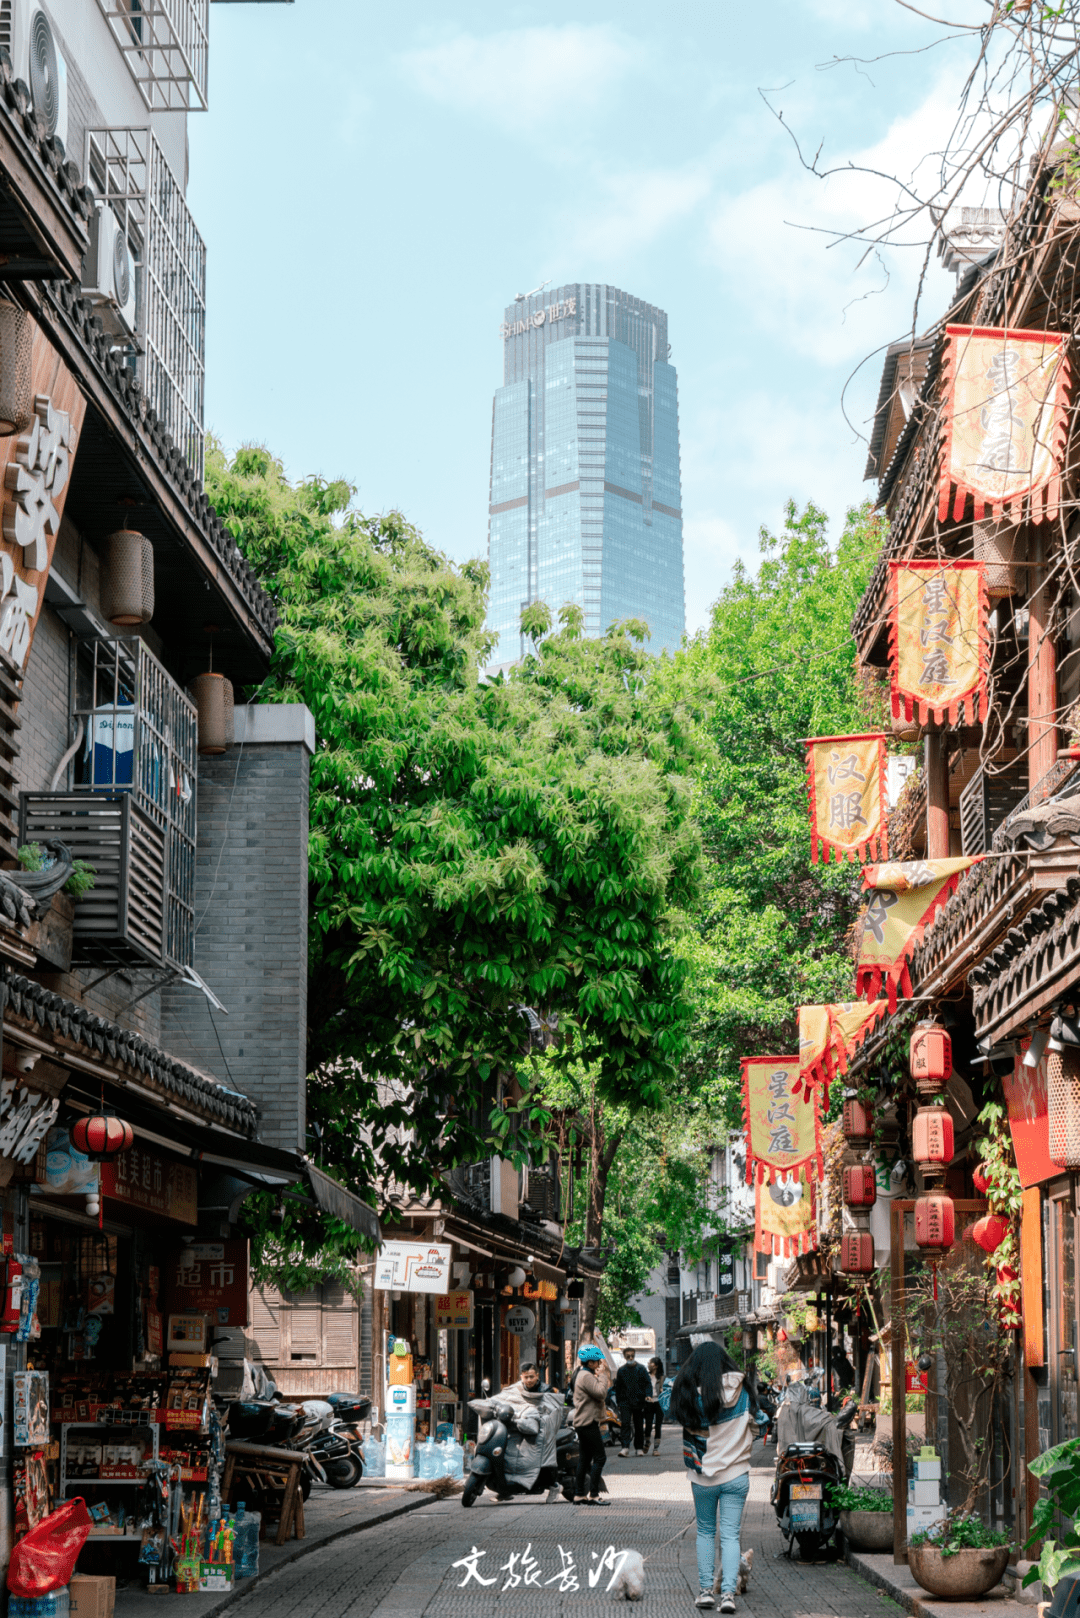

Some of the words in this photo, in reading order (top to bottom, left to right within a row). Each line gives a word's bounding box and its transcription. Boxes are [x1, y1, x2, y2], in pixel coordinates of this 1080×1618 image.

[548, 297, 577, 324] 世茂
[979, 350, 1026, 475] 星汉庭
[918, 579, 958, 686] 星汉庭
[828, 752, 868, 830] 汉服
[766, 1072, 799, 1154] 星汉庭
[175, 1261, 236, 1289] 超市
[438, 1296, 470, 1311] 超市
[508, 1317, 529, 1327] SEVEN
